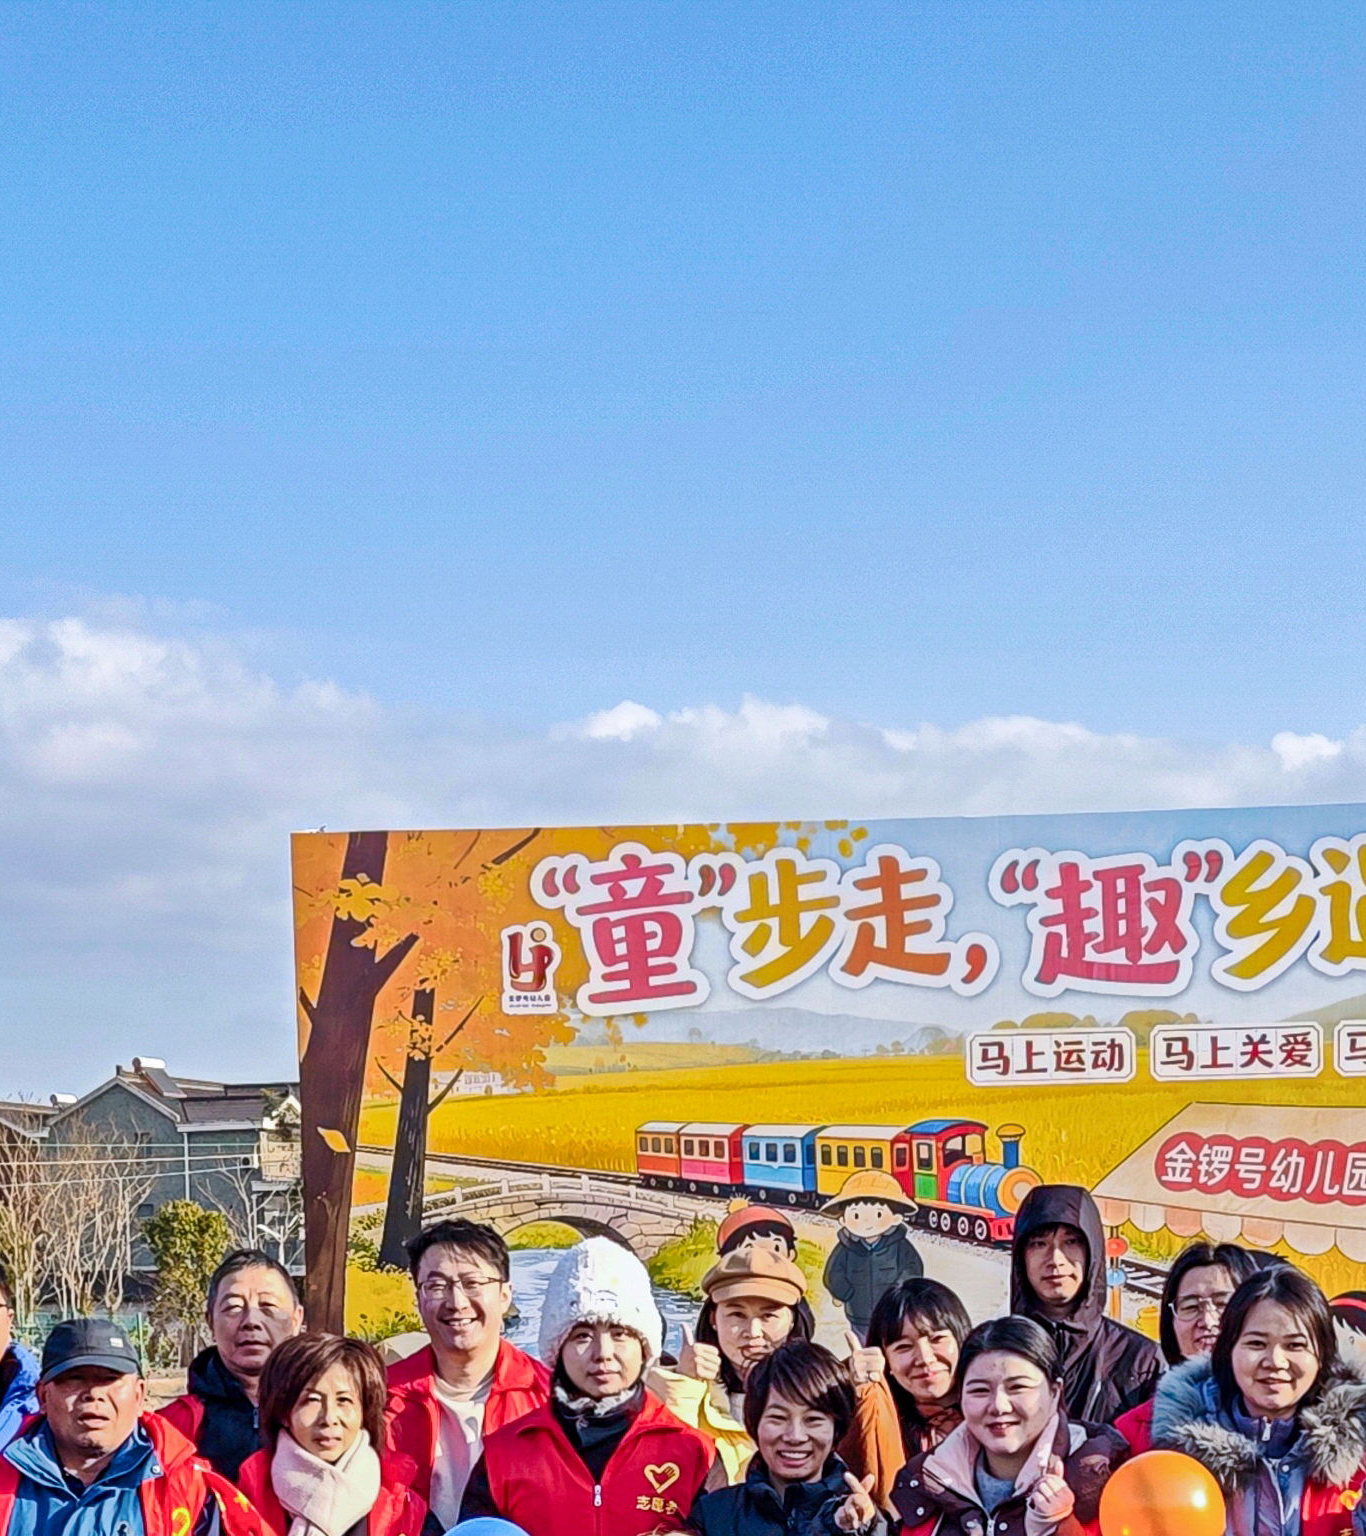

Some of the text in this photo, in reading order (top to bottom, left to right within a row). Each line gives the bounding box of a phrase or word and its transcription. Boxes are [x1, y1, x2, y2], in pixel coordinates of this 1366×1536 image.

[976, 1037, 1126, 1077] 马上运动
[1159, 1031, 1313, 1070] 马上关爱
[636, 1494, 678, 1515] 志愿者
